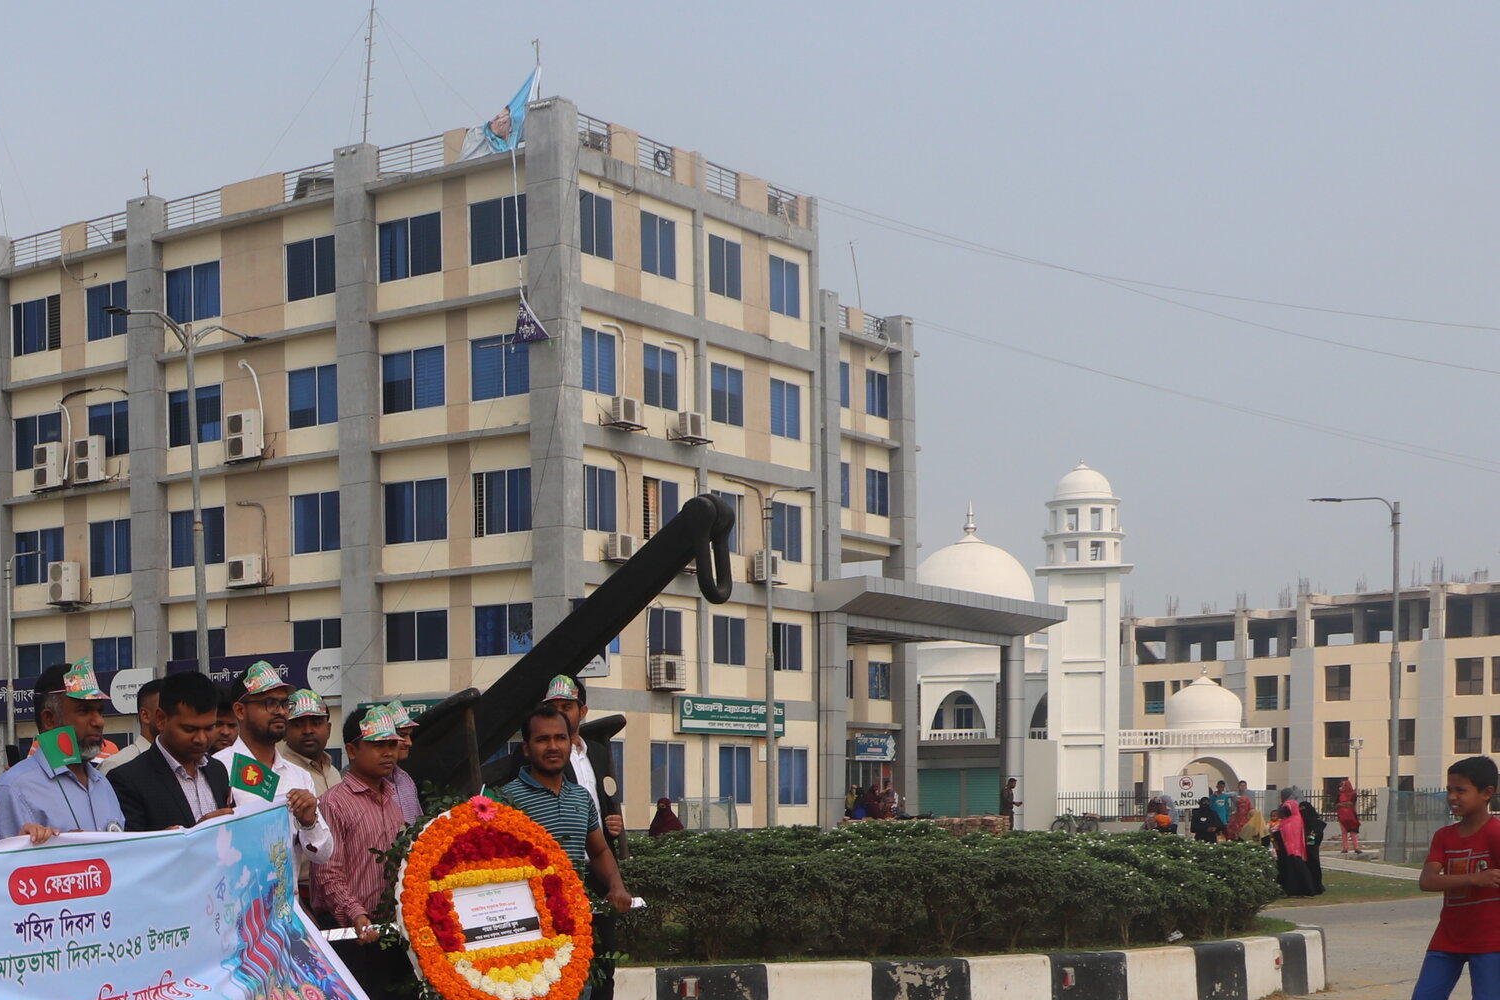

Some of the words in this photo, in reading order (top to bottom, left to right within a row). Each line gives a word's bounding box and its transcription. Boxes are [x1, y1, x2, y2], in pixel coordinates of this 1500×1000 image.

[1174, 798, 1201, 807] ARKIN
[1180, 791, 1194, 799] NO
[17, 880, 38, 899] ২১
[44, 865, 103, 895] ফেব্রুয়ারি
[14, 912, 55, 944] শহিদ
[59, 908, 96, 938] দিবস
[100, 910, 112, 929] ও
[66, 934, 143, 970] দিবস-২০২৪
[147, 924, 192, 952] উপলক্ষে
